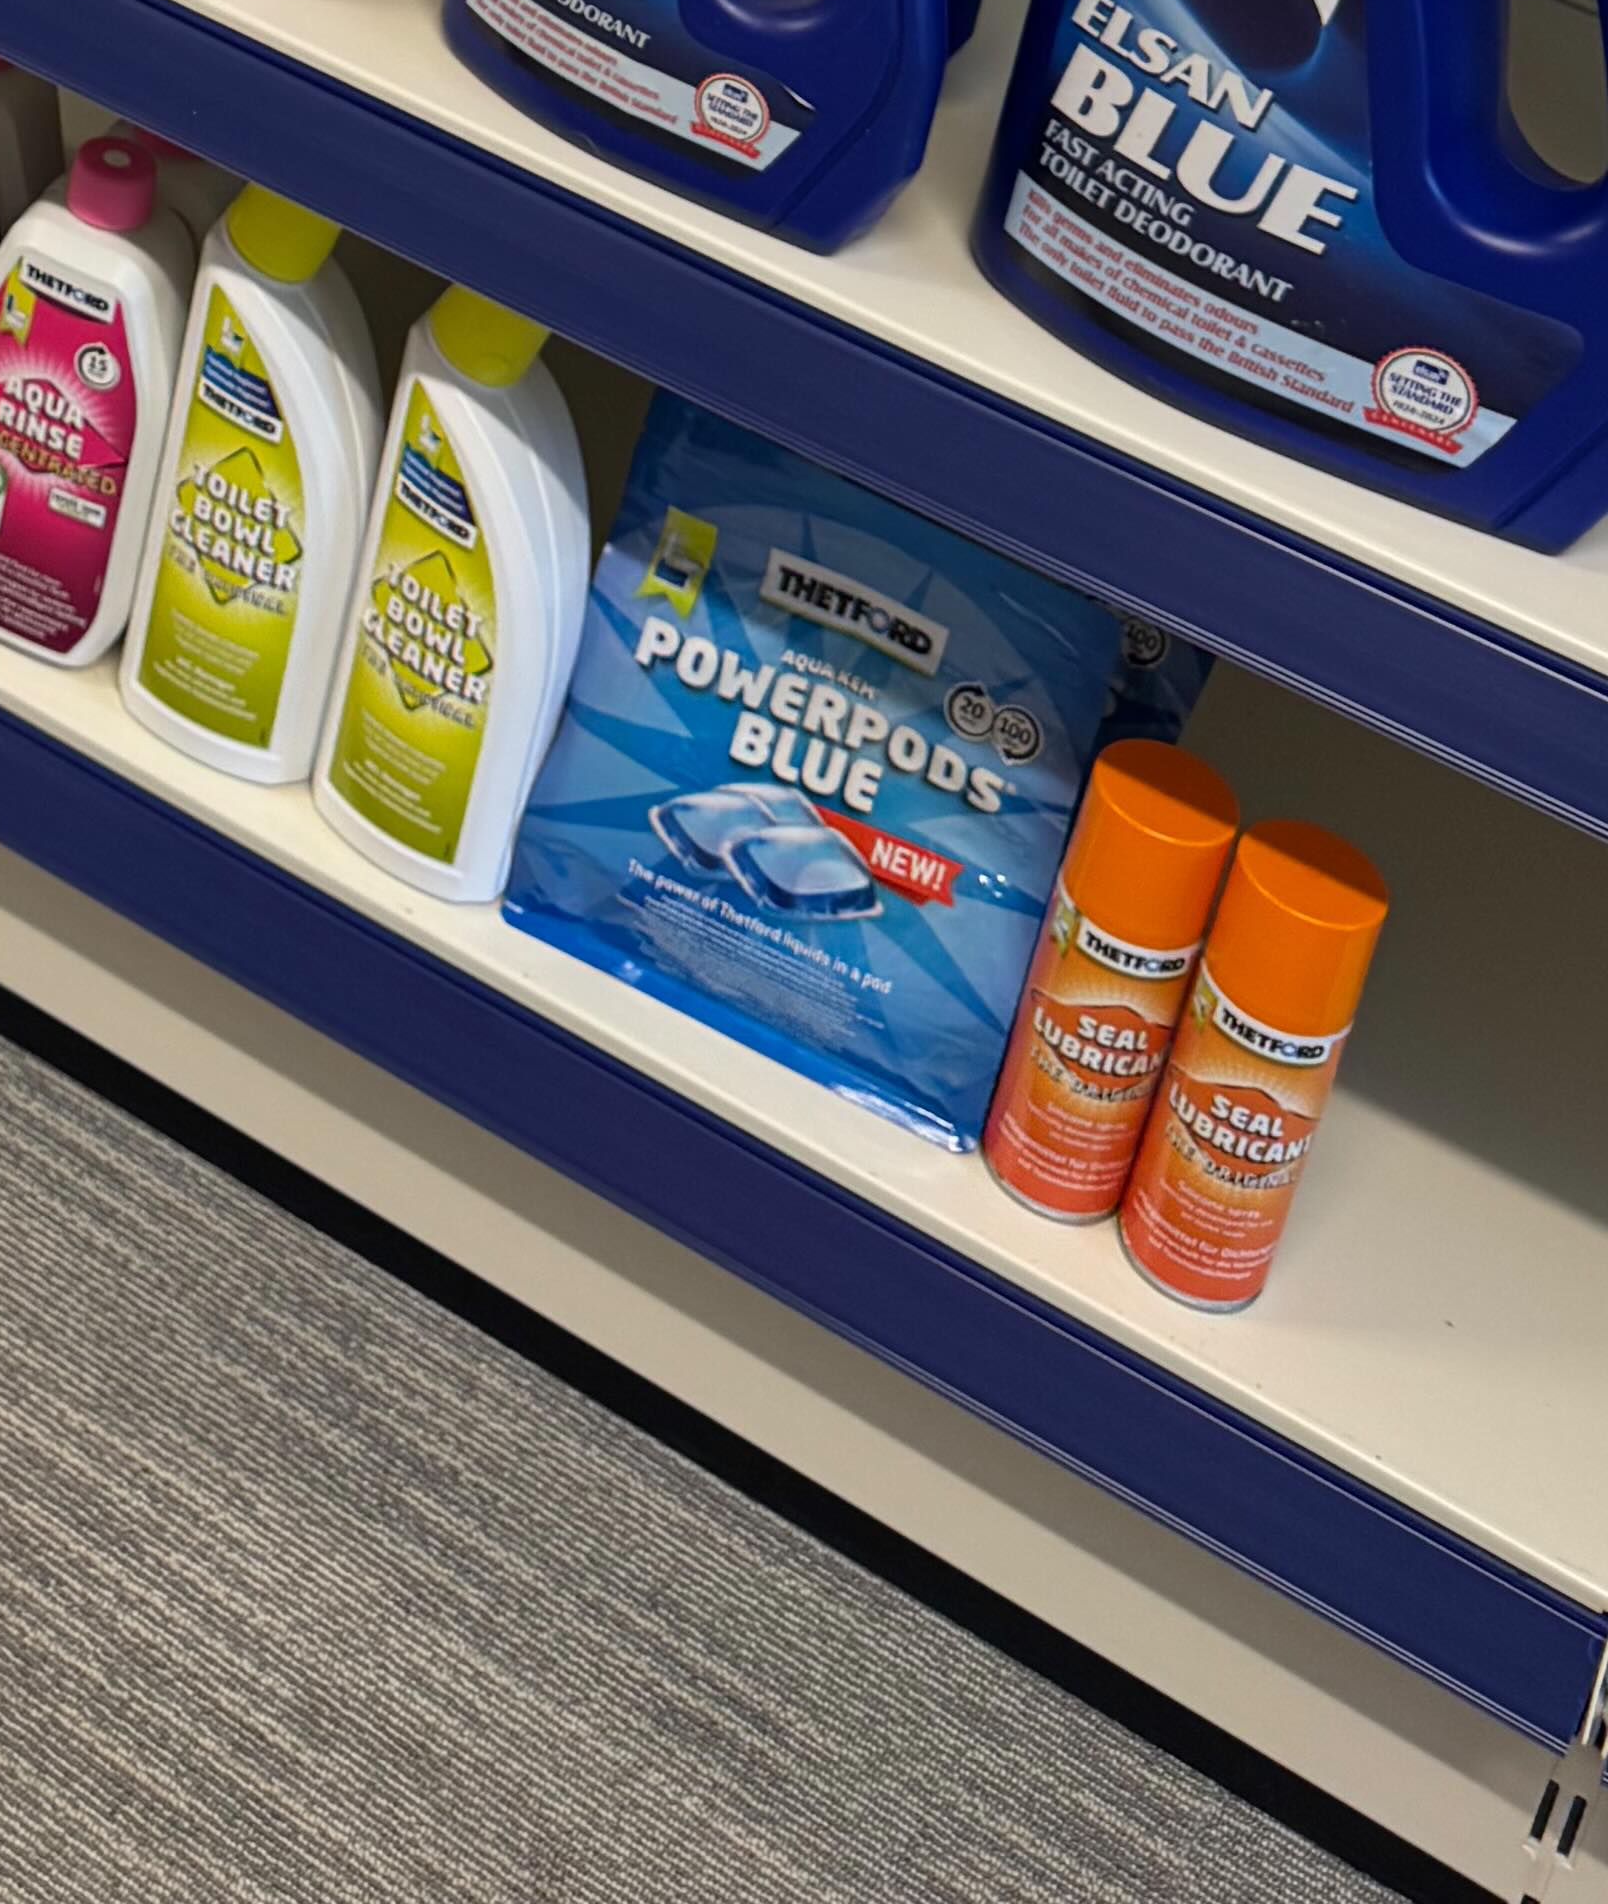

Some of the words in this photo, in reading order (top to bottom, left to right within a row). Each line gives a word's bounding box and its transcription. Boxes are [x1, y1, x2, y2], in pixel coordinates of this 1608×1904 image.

[1043, 119, 1100, 164] FAST
[1097, 157, 1196, 227] ACTING
[1050, 42, 1359, 256] BLUE
[1038, 142, 1113, 210] TOILET
[1113, 198, 1296, 304] DEODORANT
[1040, 215, 1060, 239] all
[1060, 227, 1103, 266] makes
[1103, 252, 1121, 278] of
[1121, 267, 1190, 322] chemical
[1190, 306, 1237, 341] toilet
[1250, 339, 1327, 383] cassettes
[1053, 208, 1096, 243] germs
[1095, 232, 1124, 262] and
[1124, 253, 1203, 307] eliminates
[1203, 299, 1259, 336] odours
[1017, 222, 1041, 245] The
[1040, 235, 1070, 266] only
[1069, 256, 1106, 291] toilet
[1105, 280, 1142, 316] fluid
[1141, 302, 1158, 323] to
[1158, 314, 1196, 345] pass
[1199, 333, 1226, 359] the
[1228, 348, 1279, 384] British
[1280, 372, 1355, 416] Standard
[202, 384, 277, 435] THETFORD
[1388, 372, 1437, 400] SETTING
[1436, 388, 1463, 408] THE
[1390, 383, 1455, 417] STANDARD
[193, 463, 291, 529] TOILET
[193, 494, 276, 556] BOWL
[171, 509, 295, 592] CLEANER
[778, 566, 933, 656] THETFORD
[780, 649, 835, 680] AQUA
[634, 615, 1003, 814] POWERPODS
[959, 695, 984, 718] 20
[998, 720, 1032, 748] 100
[728, 710, 883, 814] BLUE
[870, 836, 947, 891] NEW!
[628, 858, 655, 882] The
[654, 874, 700, 901] power
[700, 893, 718, 911] of
[718, 902, 782, 943] Thetford
[782, 931, 831, 966] liquids
[832, 956, 848, 975] in
[850, 967, 860, 983] a
[1084, 930, 1186, 972] THETFORD
[1077, 1013, 1149, 1051] SEAL
[1221, 1007, 1325, 1060] THETFORD
[1210, 1094, 1284, 1138] SEAL
